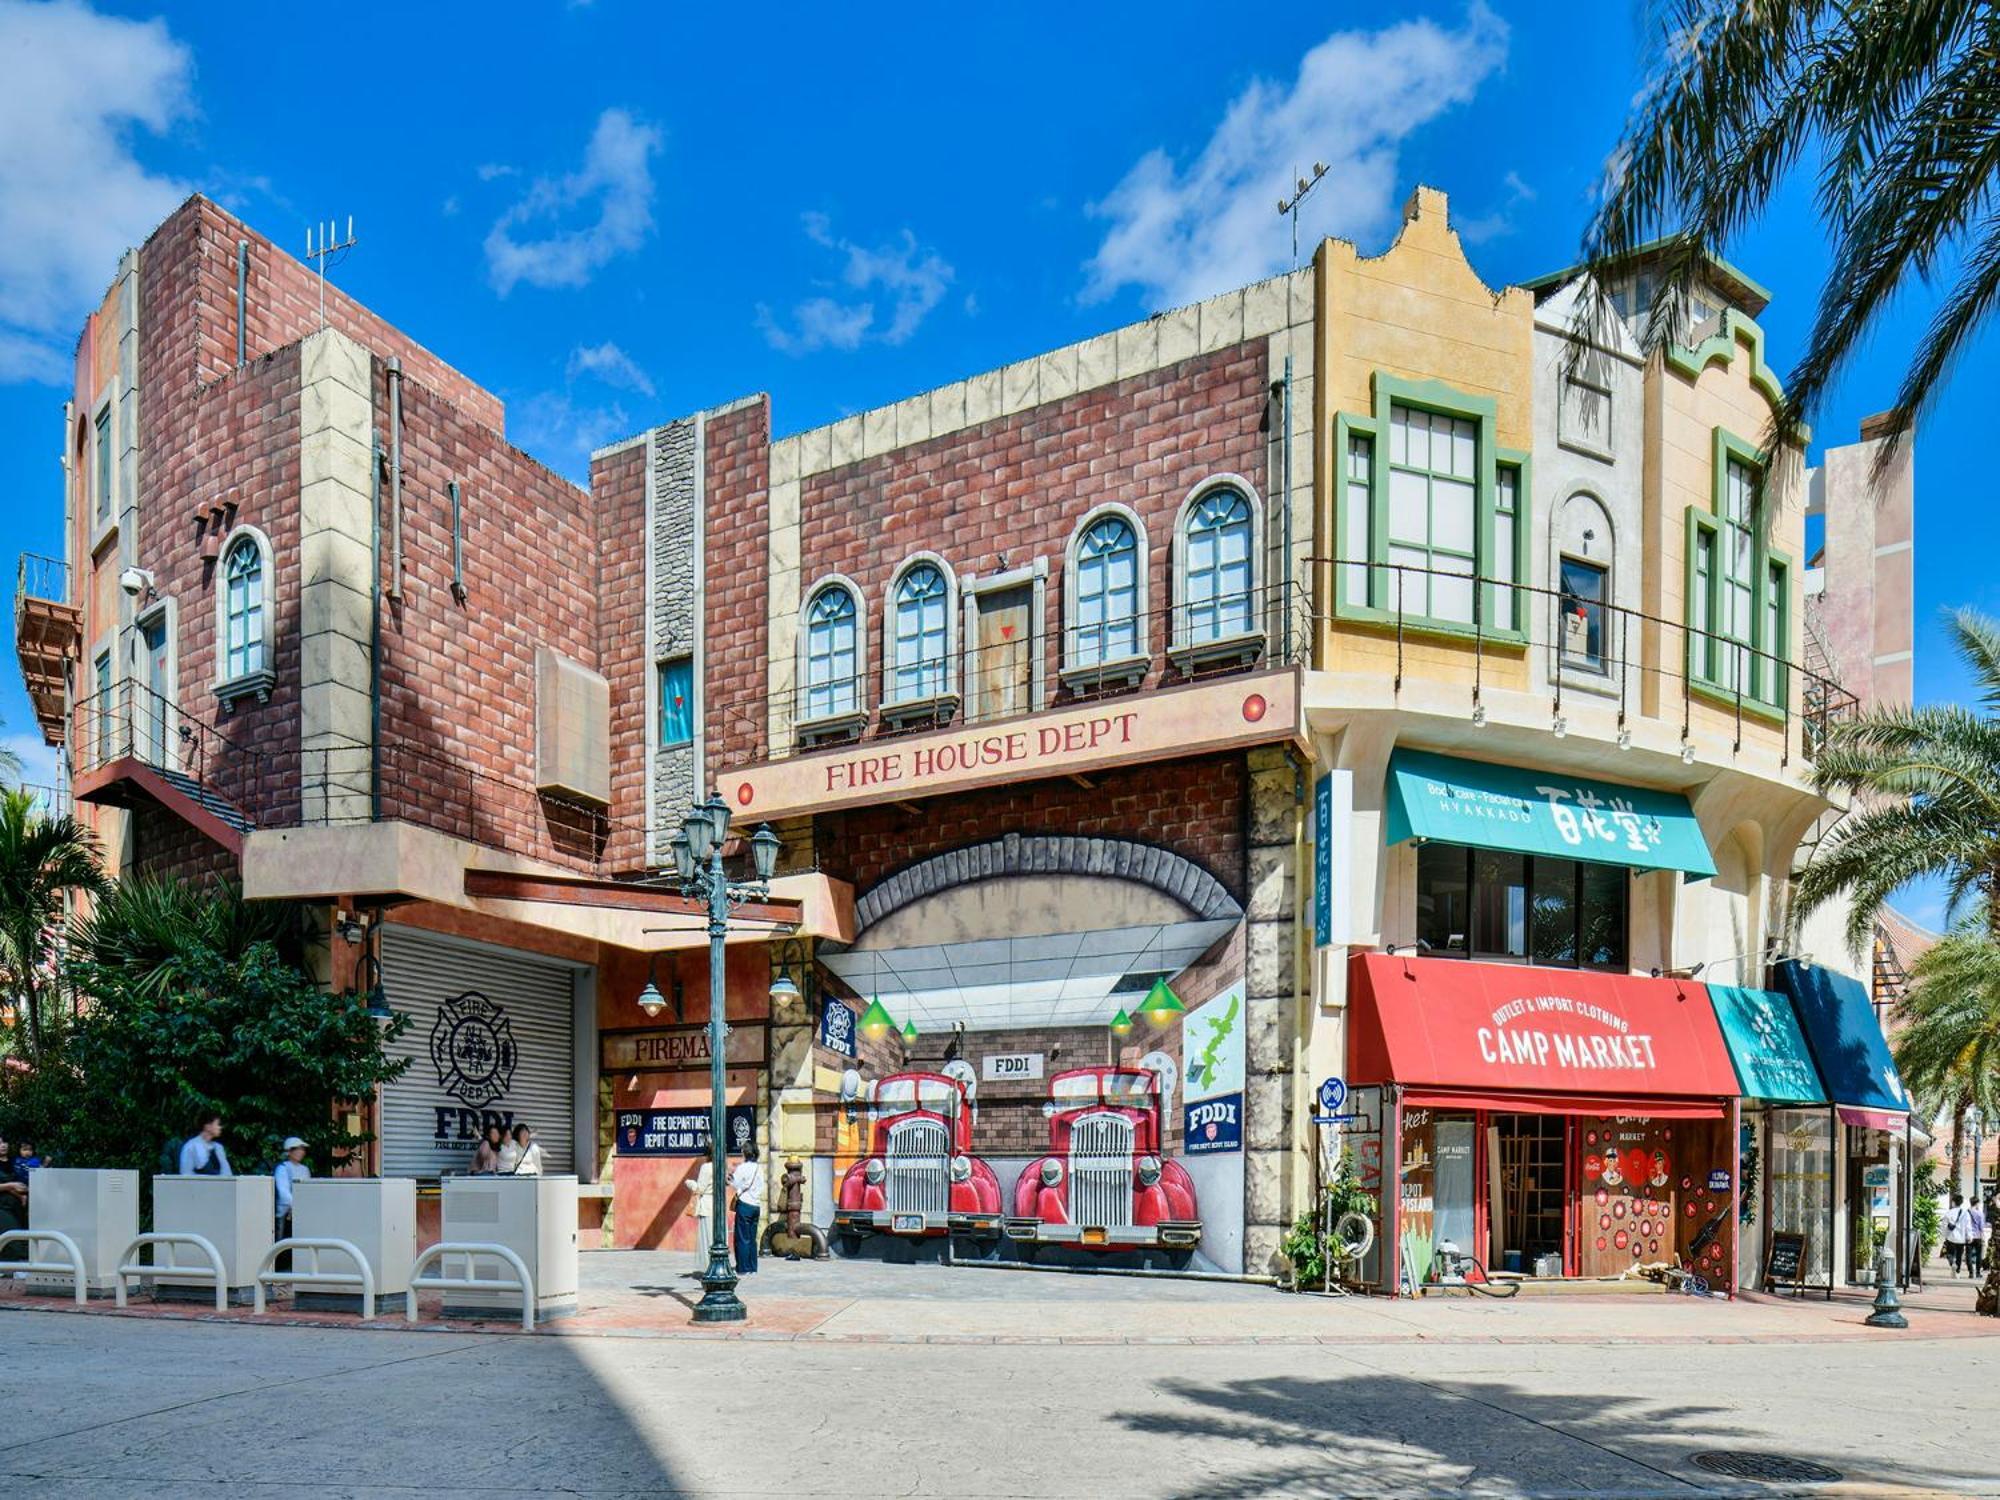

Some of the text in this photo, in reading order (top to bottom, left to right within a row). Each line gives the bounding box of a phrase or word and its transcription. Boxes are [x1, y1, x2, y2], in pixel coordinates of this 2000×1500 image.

[825, 713, 1138, 791] FIRE HOUSE DEPT
[1440, 800, 1531, 823] HYAKKADO
[1536, 785, 1649, 852] 百花堂
[460, 999, 490, 1016] FIRE
[1492, 996, 1628, 1033] OUTLET & IMPORT CLOTHING
[635, 1036, 712, 1062] FIREMA
[825, 1033, 852, 1055] FDDI
[1477, 1027, 1656, 1069] CAMP MARKET
[995, 1057, 1029, 1073] FDDI
[620, 1114, 643, 1127] FDDI
[652, 1116, 667, 1130] FIRE
[1189, 1102, 1236, 1132] FDDI
[644, 1133, 666, 1148] DEPOT
[1619, 1132, 1646, 1141] MARKET
[1437, 1145, 1471, 1154] CAMP MARKET
